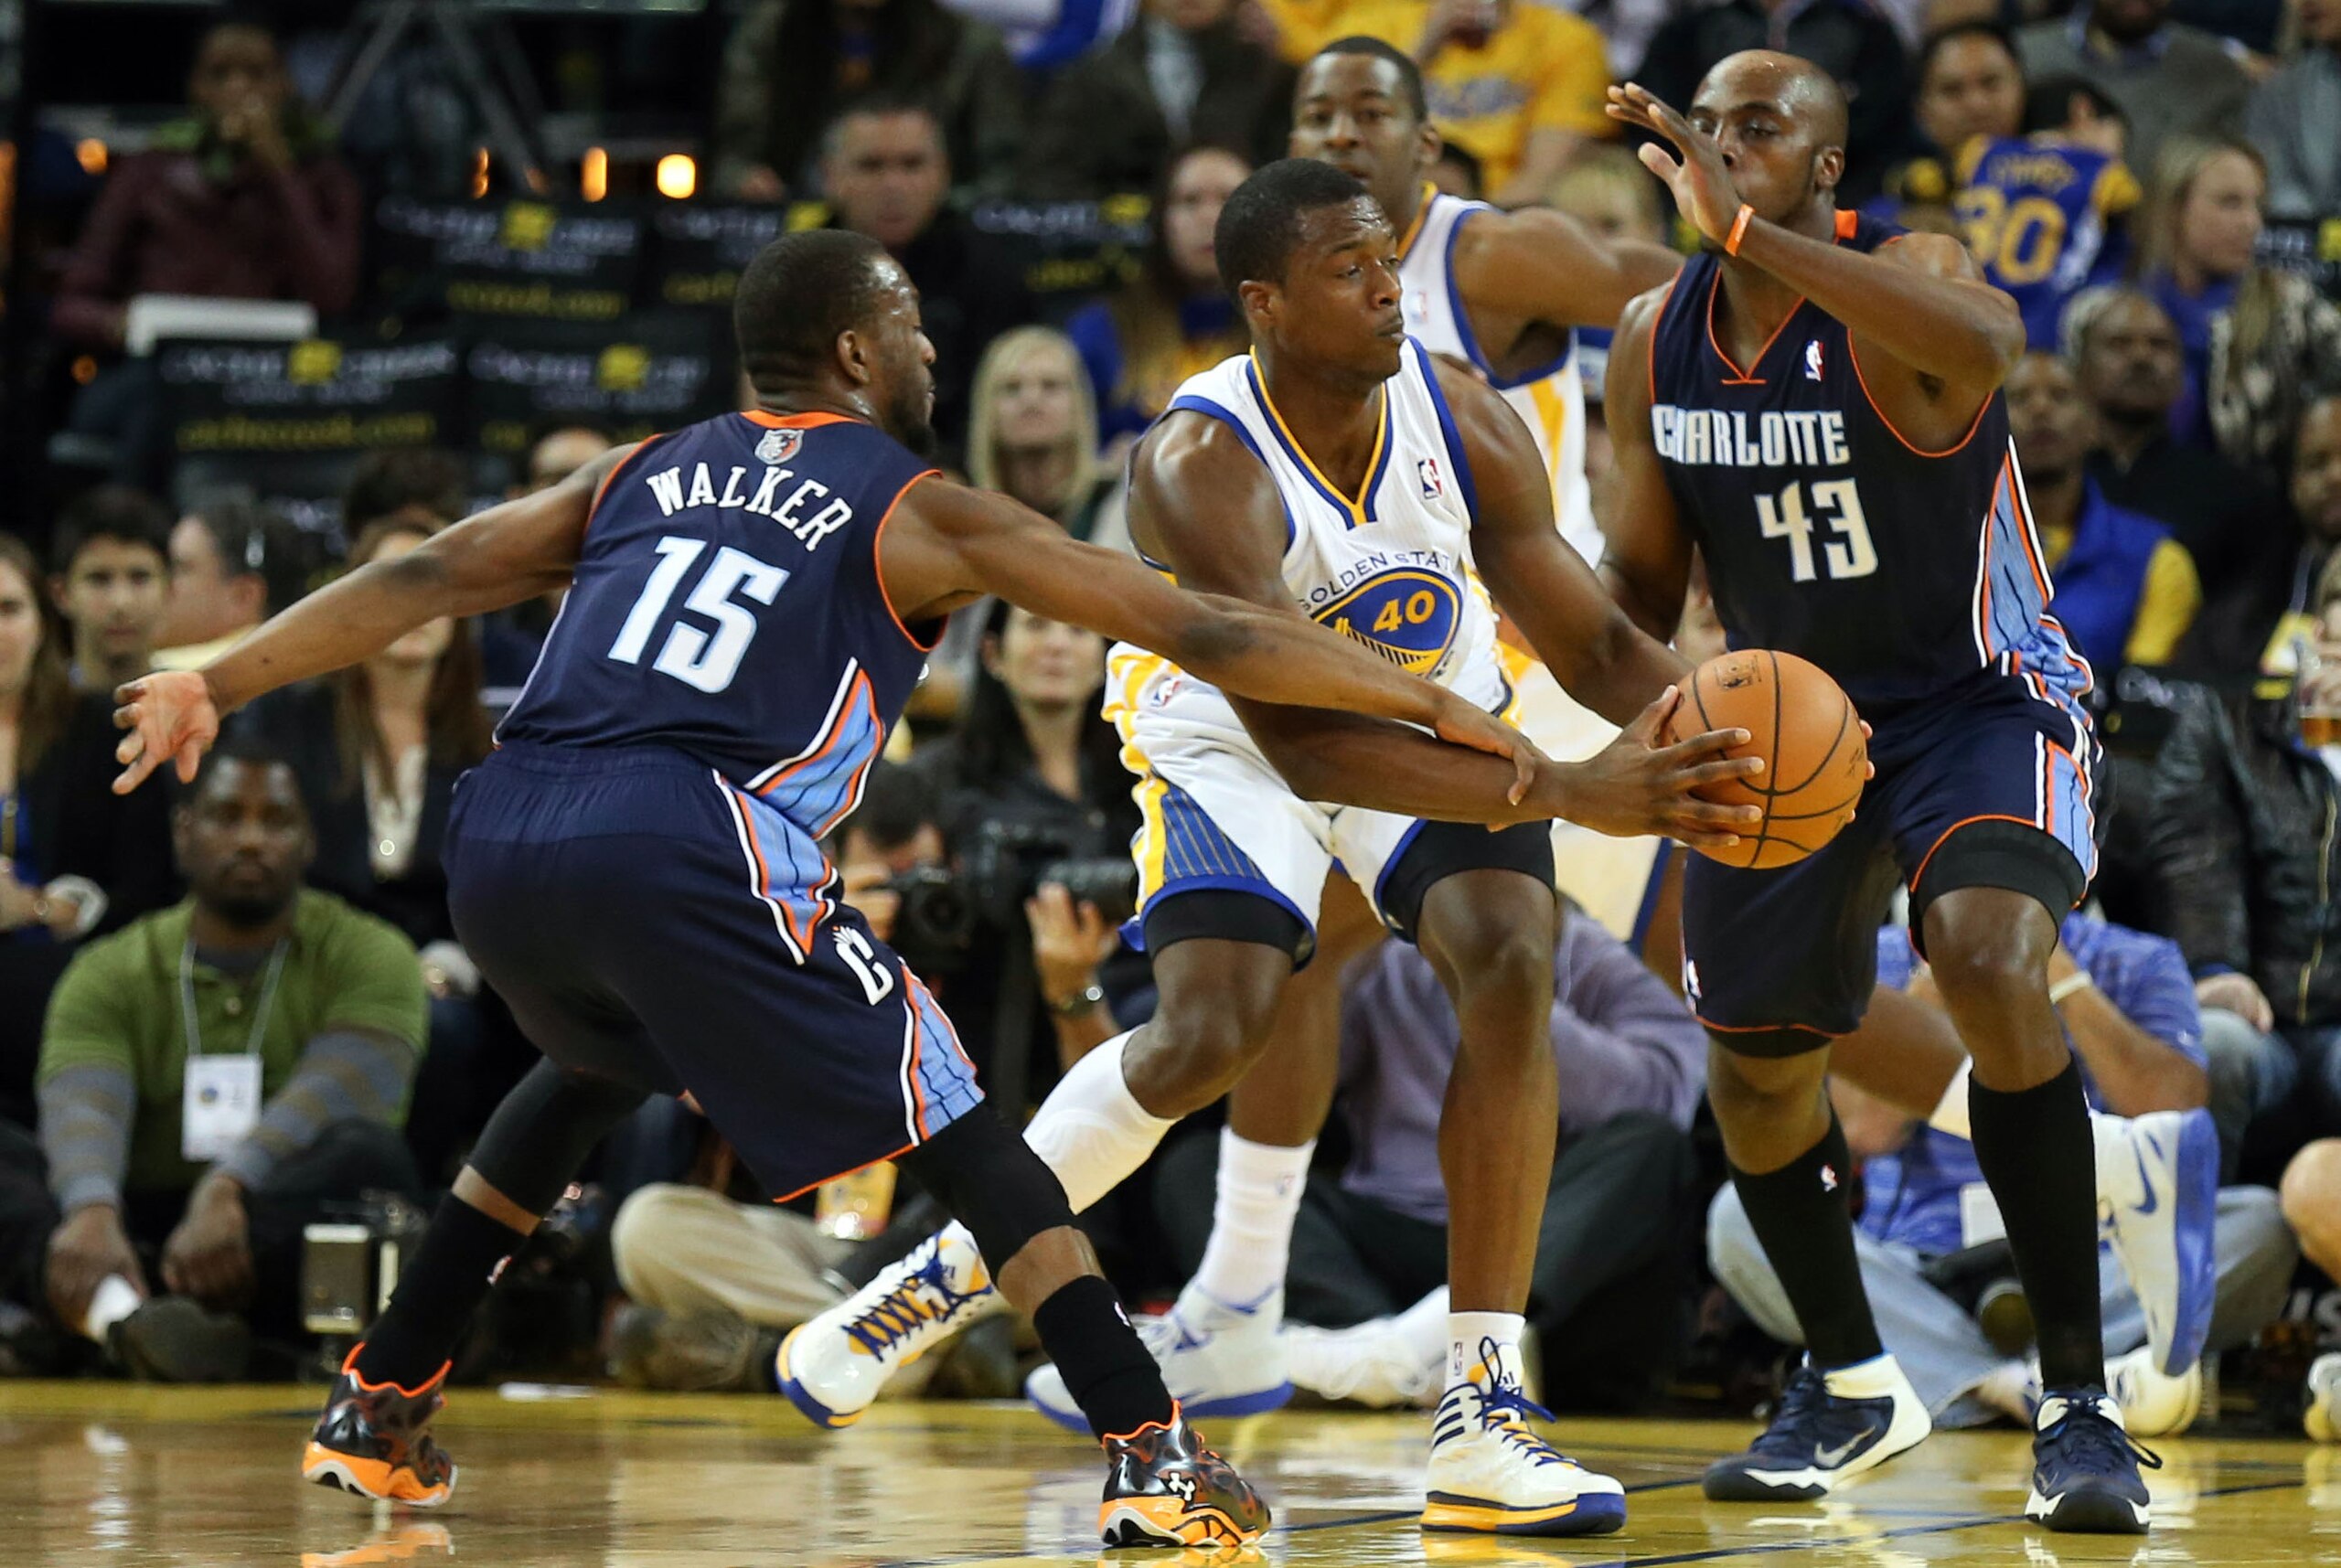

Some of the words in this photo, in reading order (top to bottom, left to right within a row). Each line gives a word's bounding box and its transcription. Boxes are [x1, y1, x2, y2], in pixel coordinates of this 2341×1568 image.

[646, 462, 852, 551] WALKER
[1753, 477, 1878, 582] 43
[1395, 550, 1450, 571] STAT
[607, 536, 791, 694] 15
[1374, 590, 1435, 633] 40
